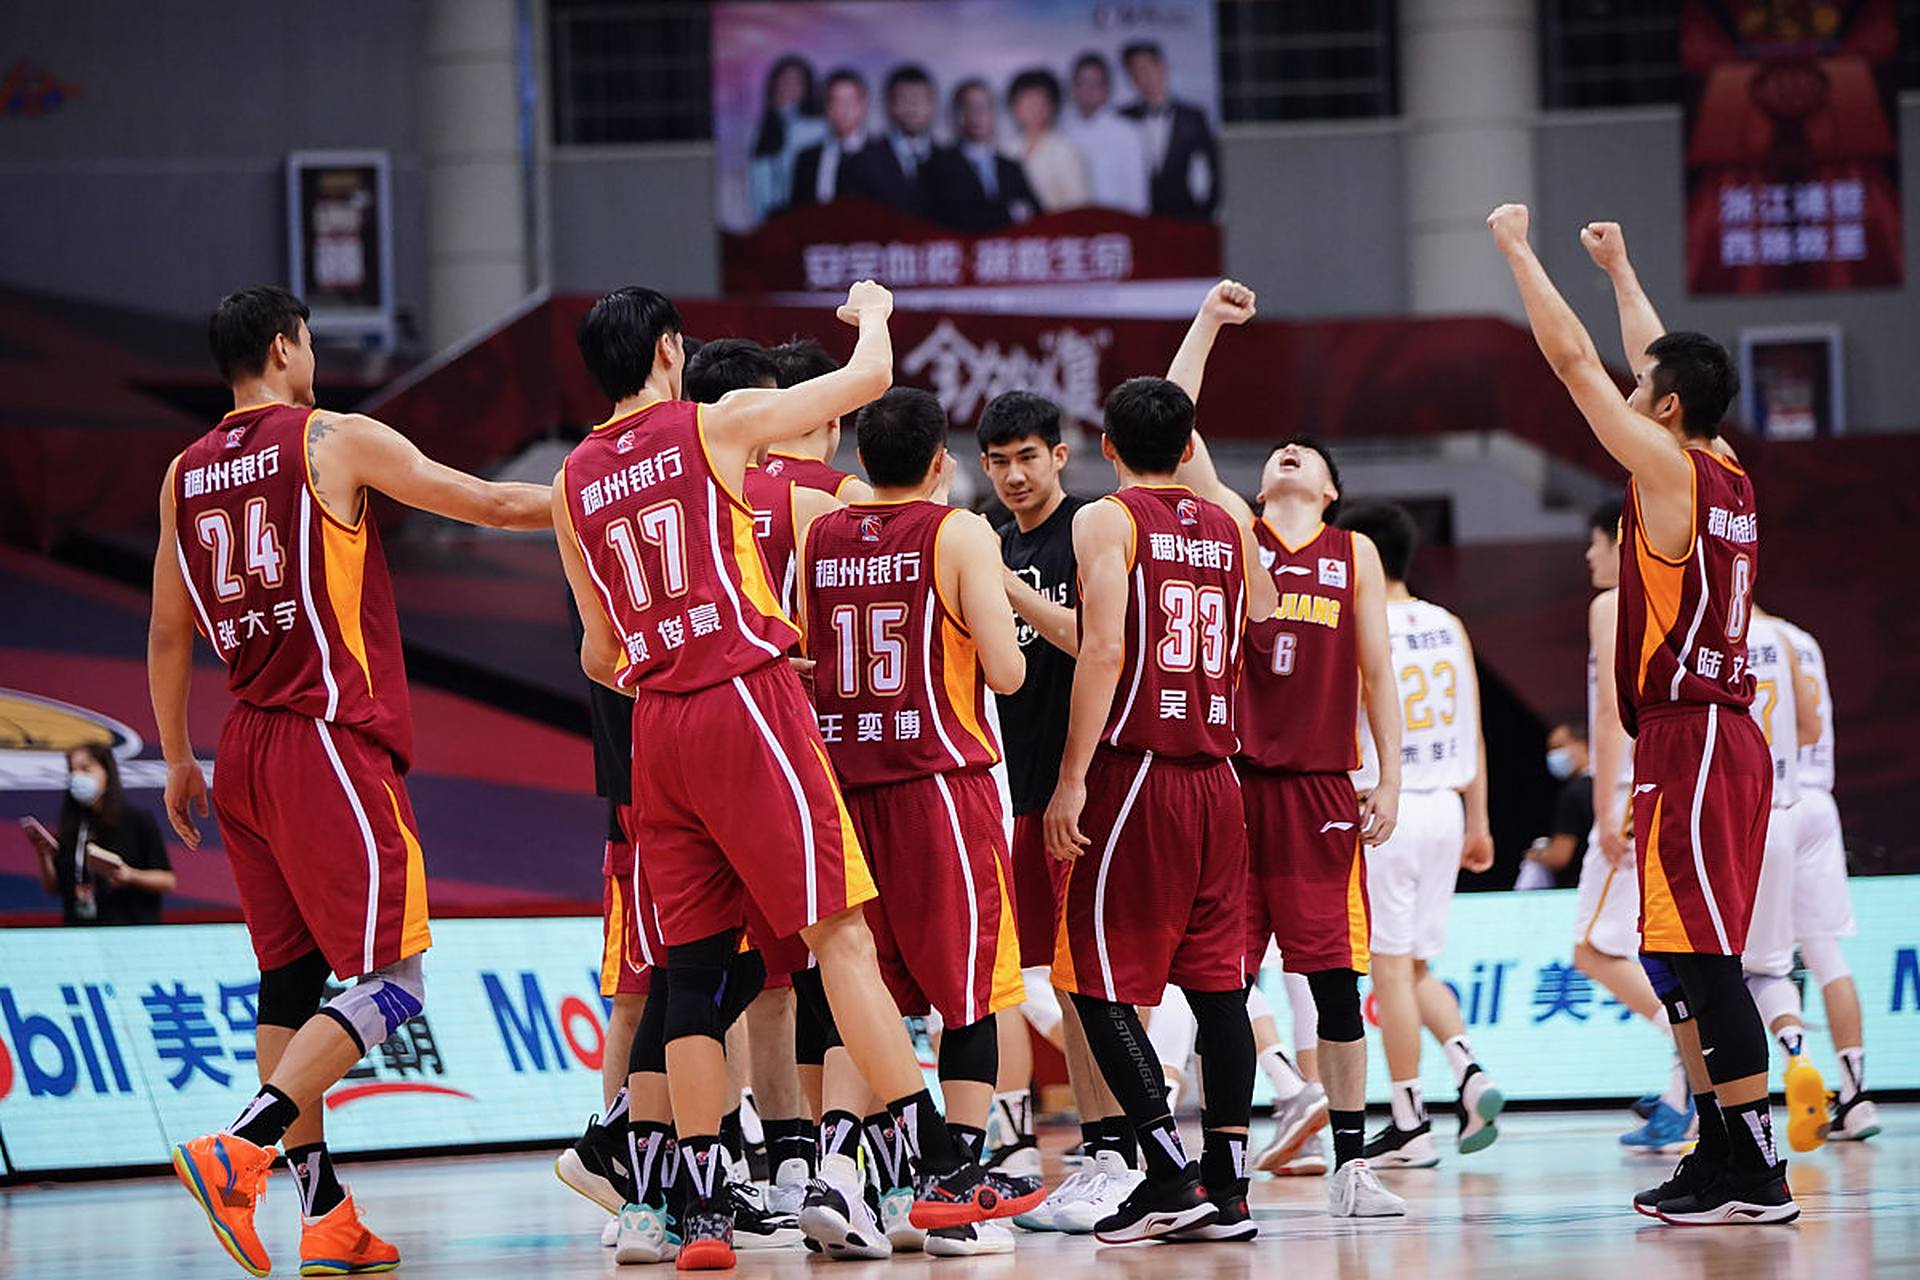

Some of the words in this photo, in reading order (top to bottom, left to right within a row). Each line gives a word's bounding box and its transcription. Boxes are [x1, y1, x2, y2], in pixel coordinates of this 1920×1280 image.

[184, 444, 279, 499] 稠州银行
[580, 446, 683, 516] 稠州银行
[195, 496, 285, 603] 24
[606, 498, 689, 612] 17
[815, 552, 921, 589] 稠州银行
[1150, 533, 1233, 572] 稠州银行
[217, 600, 297, 650] 张大宇
[1157, 578, 1227, 679] 33
[1271, 593, 1341, 630] JIANG
[831, 601, 909, 698] 15
[1271, 631, 1297, 676] 6
[819, 709, 921, 743] 王奕博
[1159, 688, 1227, 726] 吴前
[1401, 660, 1456, 732] 23
[0, 982, 133, 1098] bil
[481, 971, 612, 1073] Mo
